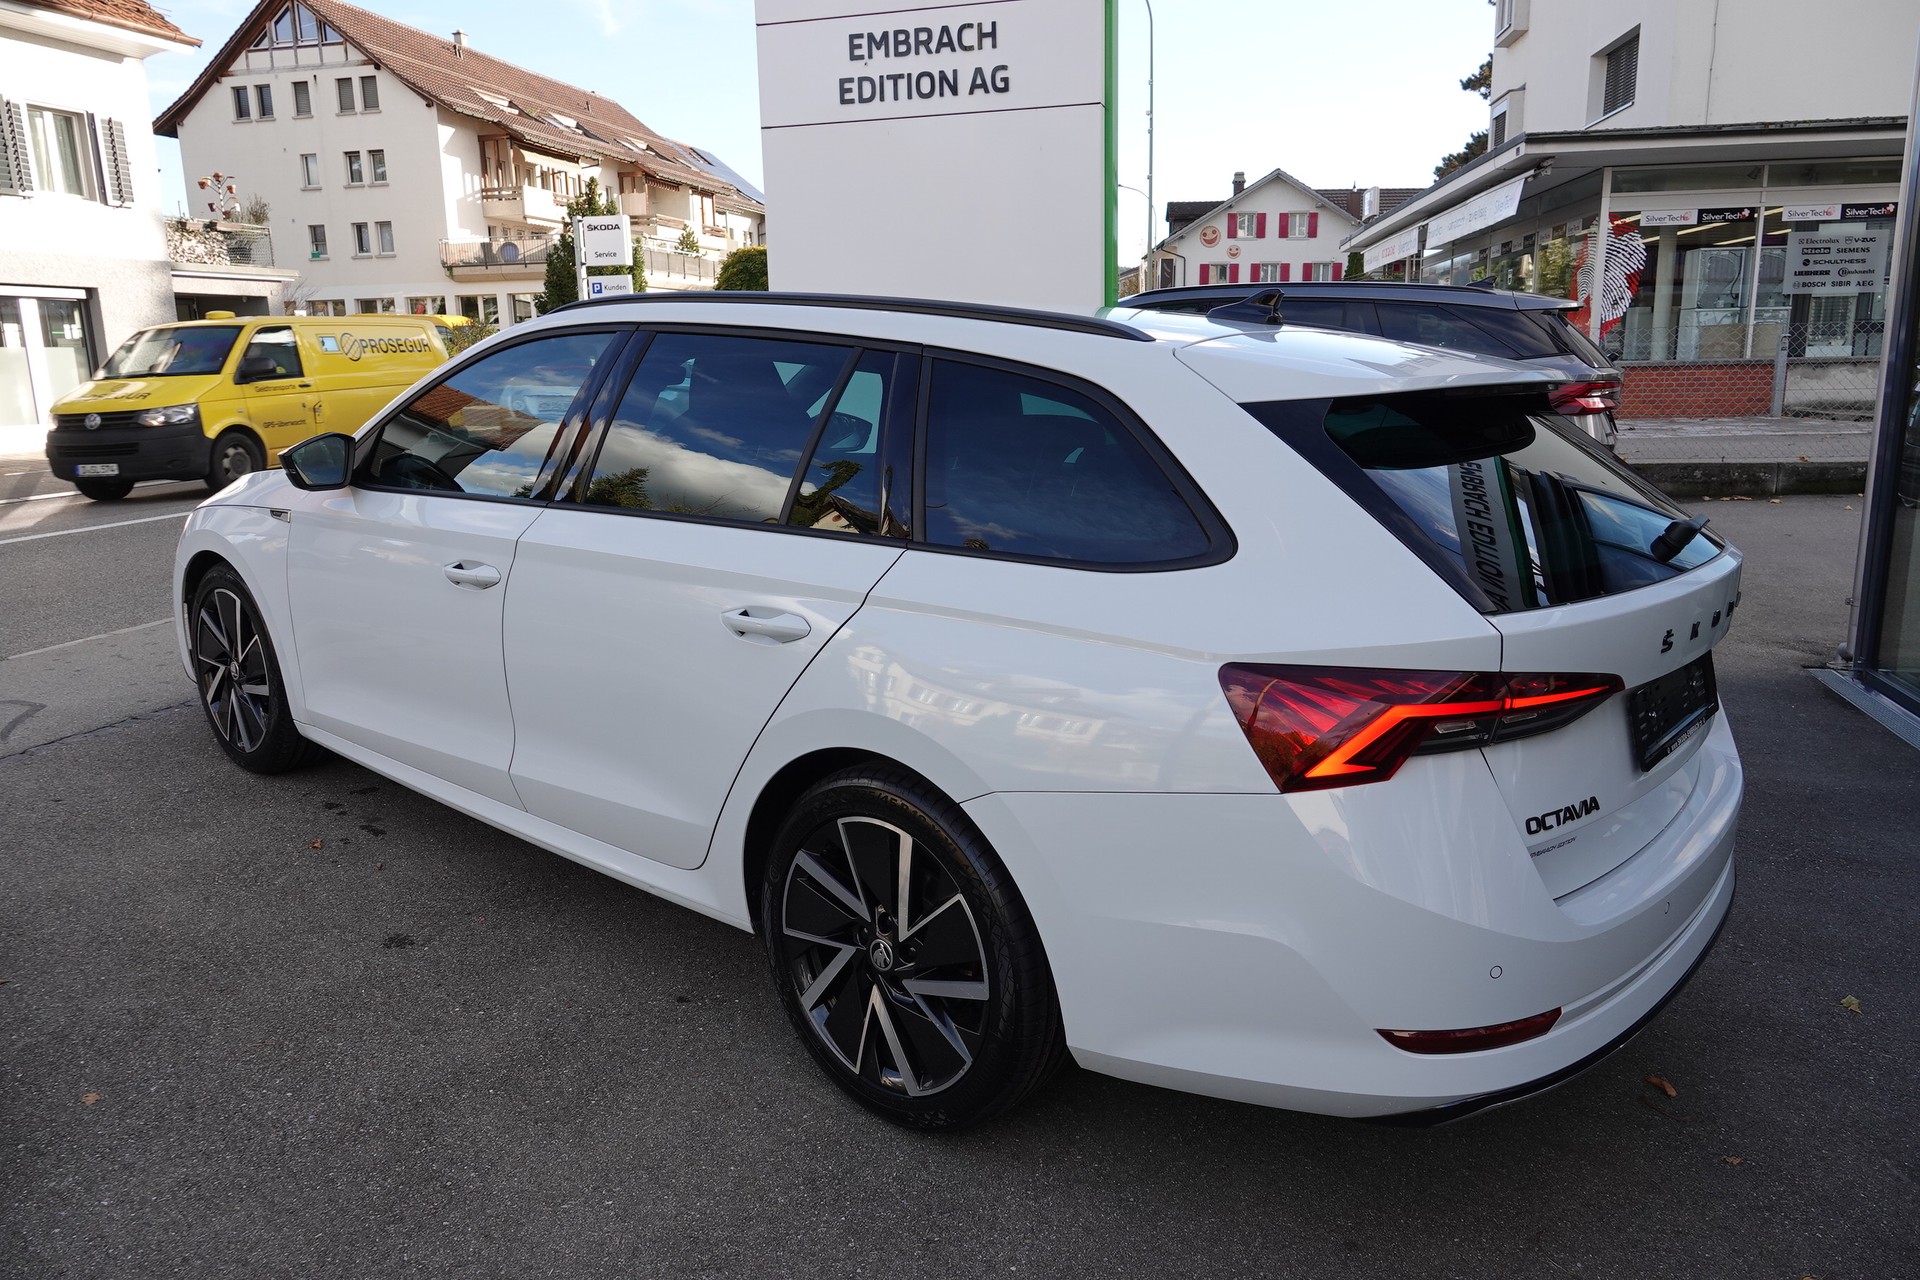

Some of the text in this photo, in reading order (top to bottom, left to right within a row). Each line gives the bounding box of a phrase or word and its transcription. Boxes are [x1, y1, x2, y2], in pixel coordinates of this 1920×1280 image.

[848, 21, 998, 62] EMBRACH
[838, 64, 1010, 105] EDITION AG
[586, 223, 621, 232] ŠKODA
[1805, 237, 1840, 245] Electrolux
[1802, 246, 1871, 255] Miele SIEMENS
[1794, 269, 1831, 277] LIEBHERR
[361, 337, 432, 354] PROSEGUR
[1525, 795, 1601, 836] OCTAVIA
